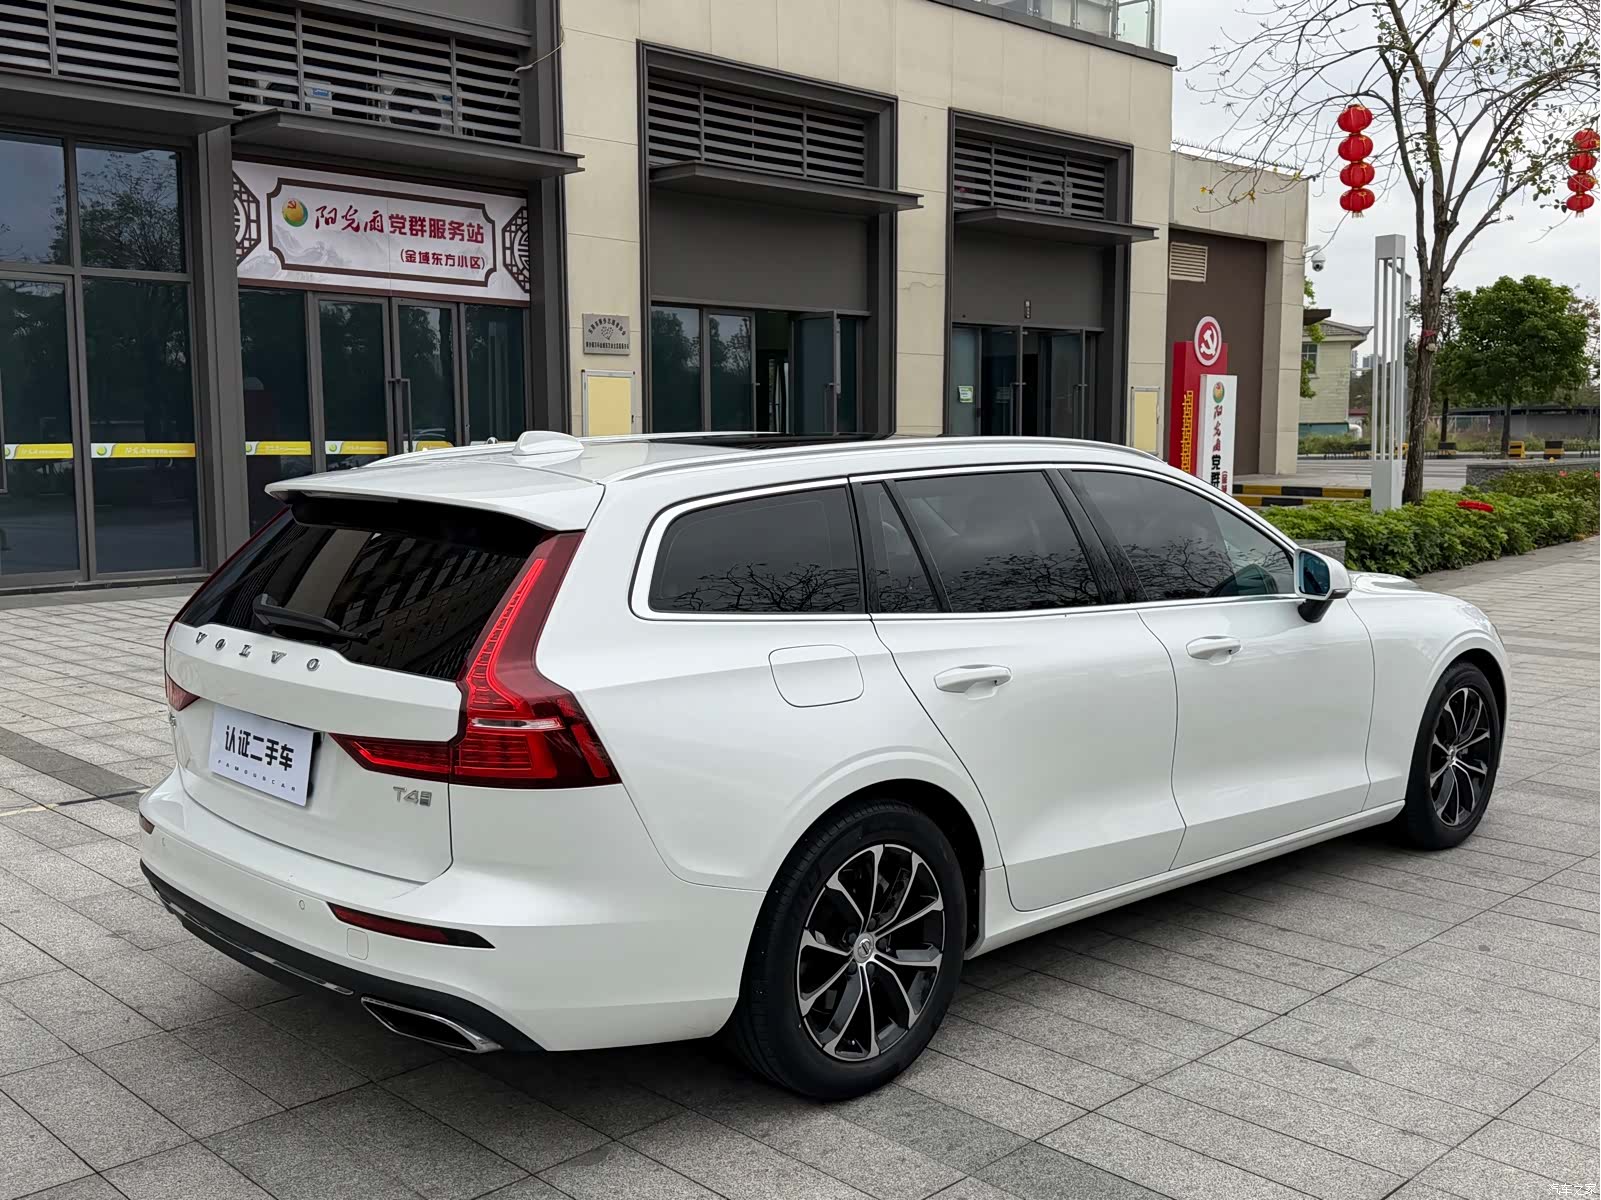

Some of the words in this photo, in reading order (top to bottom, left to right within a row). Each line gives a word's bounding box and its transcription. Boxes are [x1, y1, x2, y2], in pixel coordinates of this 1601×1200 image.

[195, 631, 320, 672] VOLVO
[225, 724, 294, 772] 认证二手车
